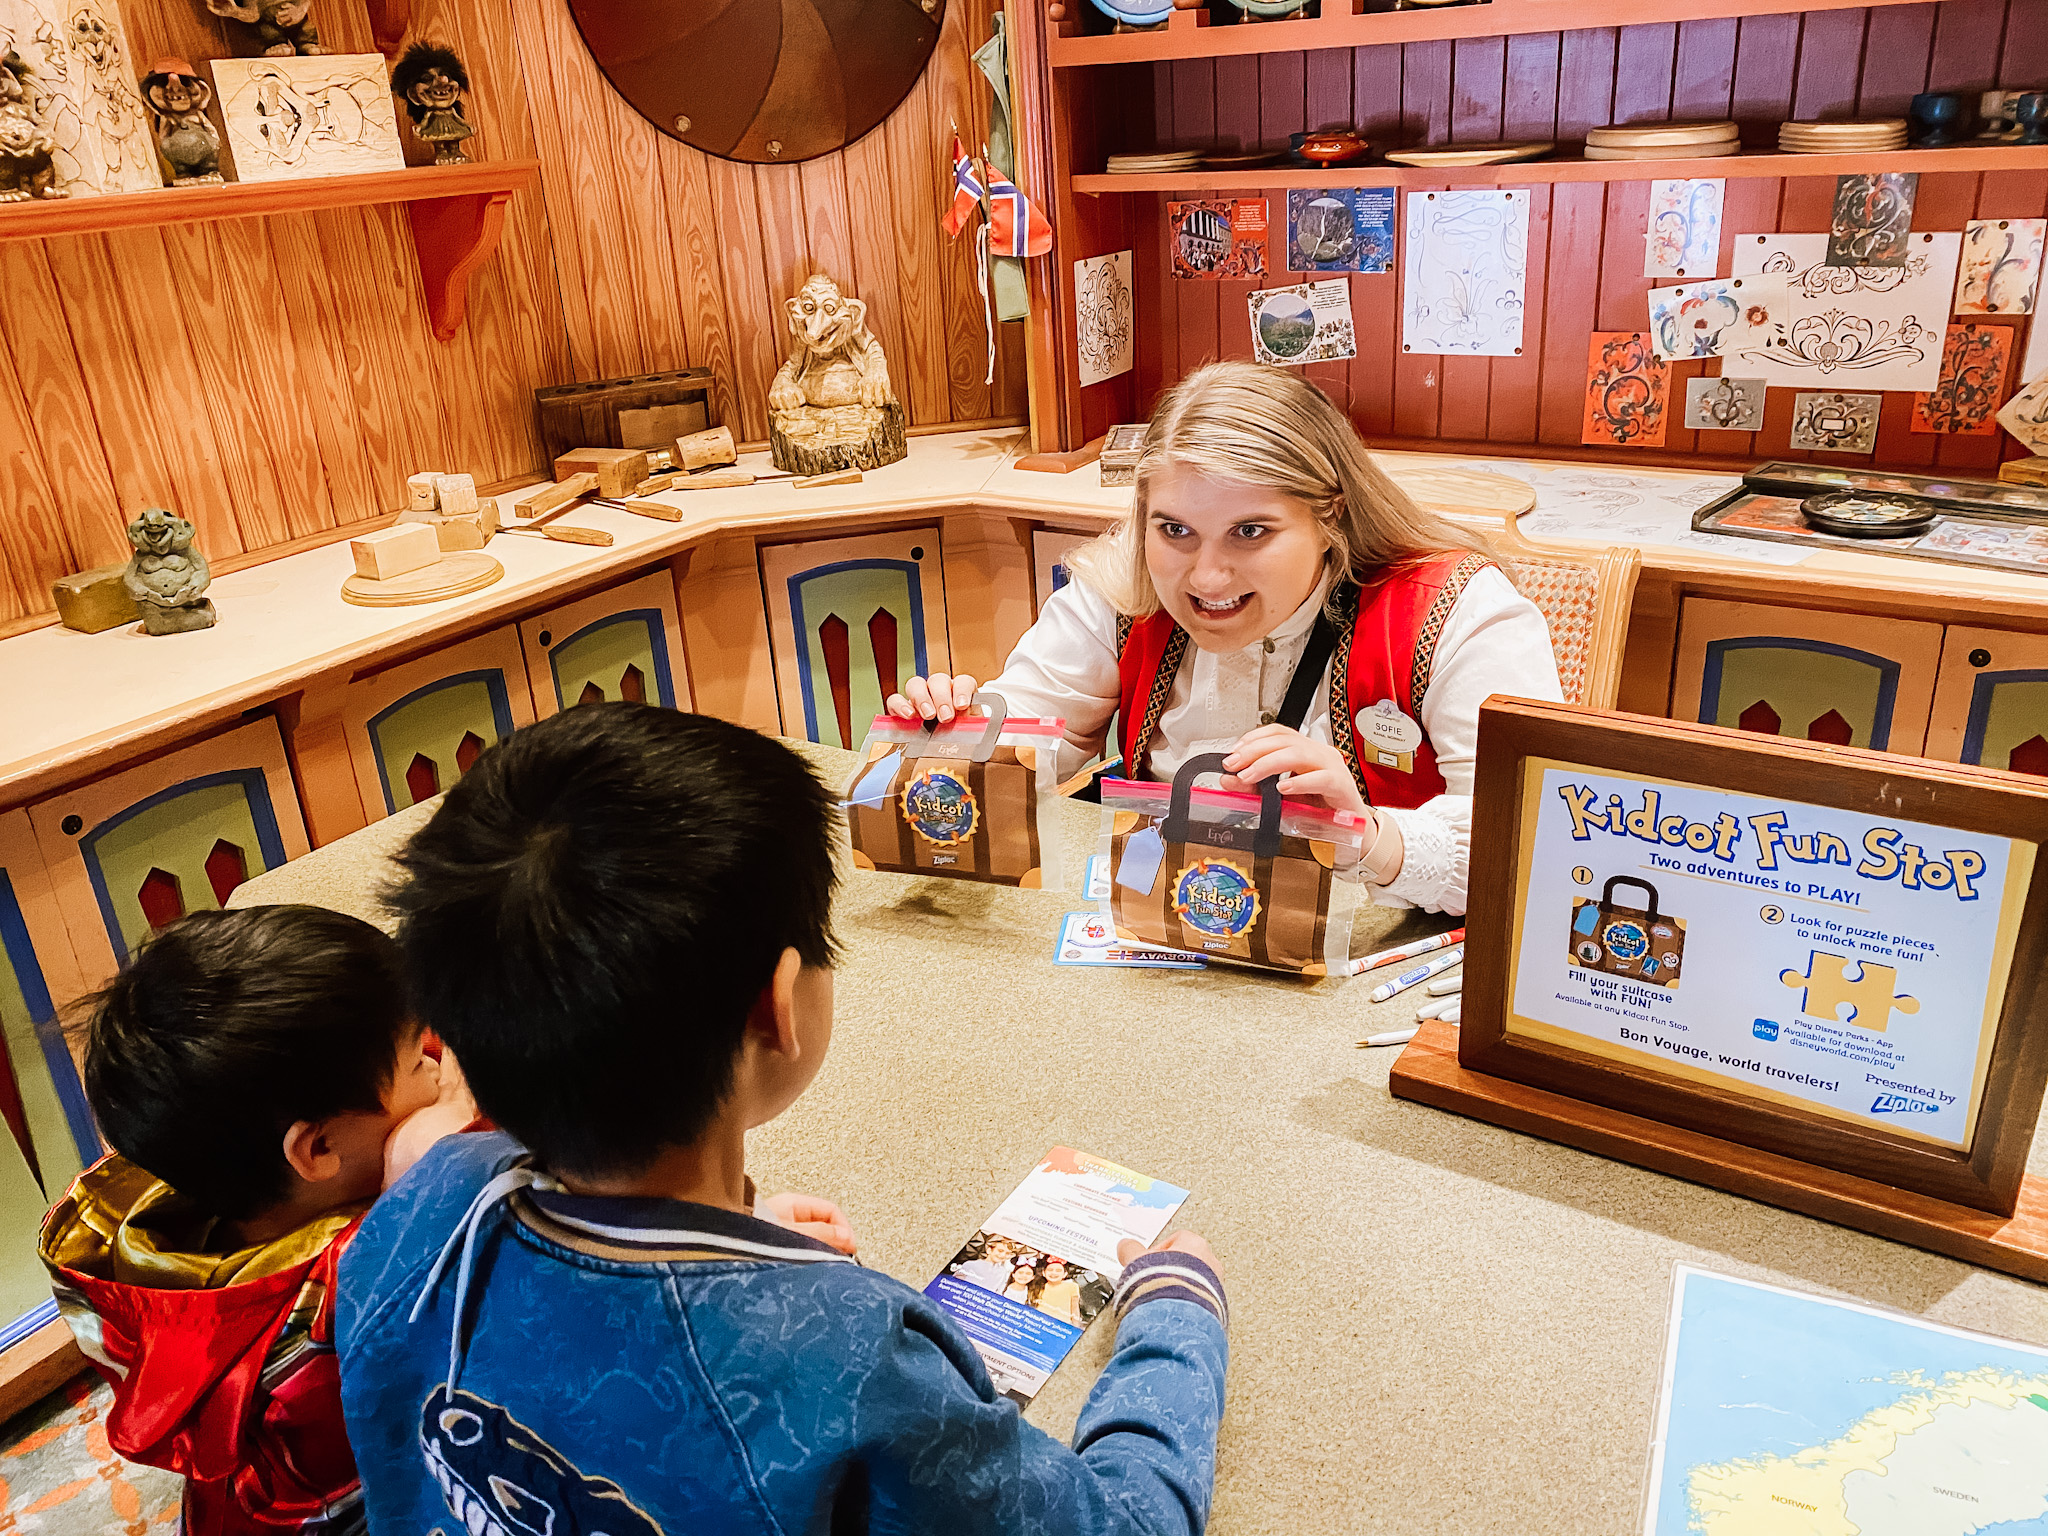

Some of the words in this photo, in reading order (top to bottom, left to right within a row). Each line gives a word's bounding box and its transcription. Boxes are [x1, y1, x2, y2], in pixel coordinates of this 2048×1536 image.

[1375, 722, 1402, 736] SOFIE
[912, 795, 964, 817] Kidcot
[1558, 784, 1742, 863] Kidcot
[1748, 811, 1851, 870] Fun
[1649, 853, 1681, 870] Two
[1687, 863, 1779, 889] adventures
[1785, 880, 1800, 893] to
[1808, 884, 1860, 905] PLAY!
[1187, 884, 1242, 911] Kidcot
[1195, 903, 1212, 914] Fun
[1790, 913, 1822, 928] Look
[1826, 920, 1843, 932] for
[1846, 925, 1888, 942] puzzle
[1892, 936, 1935, 952] pieces
[1138, 952, 1196, 962] NORWAY
[1797, 928, 1809, 938] to
[1813, 933, 1856, 948] unlock
[1860, 942, 1892, 956] more
[1897, 948, 1924, 962] fun!
[1568, 970, 1586, 982] Fill
[1590, 976, 1618, 990] your
[1622, 984, 1672, 1004] suitcase
[1590, 988, 1617, 1001] with
[1622, 994, 1652, 1009] FUN!
[1554, 992, 1592, 1008] Available
[1604, 1006, 1620, 1016] any
[1623, 1009, 1649, 1022] Kidcot
[1651, 1016, 1666, 1026] Fun
[1668, 1020, 1690, 1032] Stop.
[1753, 1024, 1777, 1037] play
[1794, 1020, 1812, 1030] Play
[1815, 1024, 1843, 1037] Disney
[1846, 1031, 1869, 1042] Parks
[1876, 1038, 1894, 1049] App
[1784, 1026, 1826, 1044] Available
[1828, 1037, 1841, 1048] for
[1844, 1040, 1892, 1060] download
[1895, 1054, 1905, 1062] at
[1790, 1038, 1896, 1070] disneyworld.com/play
[1620, 1028, 1648, 1044] Bon
[1653, 1036, 1712, 1062] Voyage,
[1718, 1053, 1761, 1072] world
[1766, 1065, 1840, 1092] travelers!
[1865, 1073, 1936, 1100] Presented
[1938, 1090, 1956, 1106] by
[1871, 1092, 1938, 1114] Ziploc
[1078, 1166, 1095, 1174] OUR
[1083, 1161, 1111, 1173] THANK
[1111, 1171, 1127, 1180] YOU
[1028, 1216, 1066, 1233] UPCOMING
[1065, 1230, 1100, 1246] FESTIVAL
[984, 1301, 1007, 1314] Disney
[1002, 1302, 1024, 1314] Disney
[1000, 1315, 1025, 1328] Memory
[1007, 1364, 1036, 1381] OPTIONS
